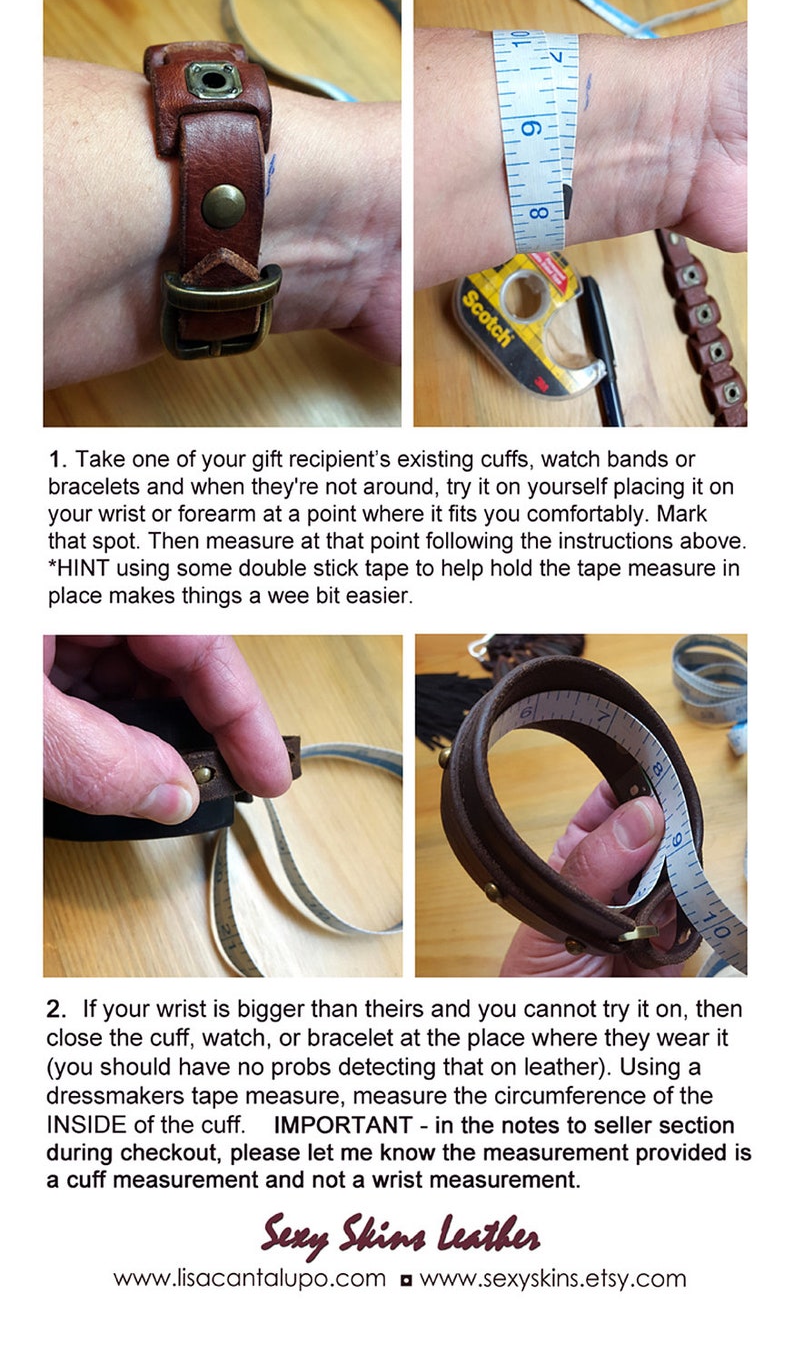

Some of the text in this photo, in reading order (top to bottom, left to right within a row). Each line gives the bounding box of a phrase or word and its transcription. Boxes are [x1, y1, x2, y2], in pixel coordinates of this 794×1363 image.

[511, 31, 532, 48] 10
[521, 120, 542, 137] 9
[529, 207, 549, 220] 8
[462, 289, 512, 348] Scotch
[652, 762, 664, 777] 8
